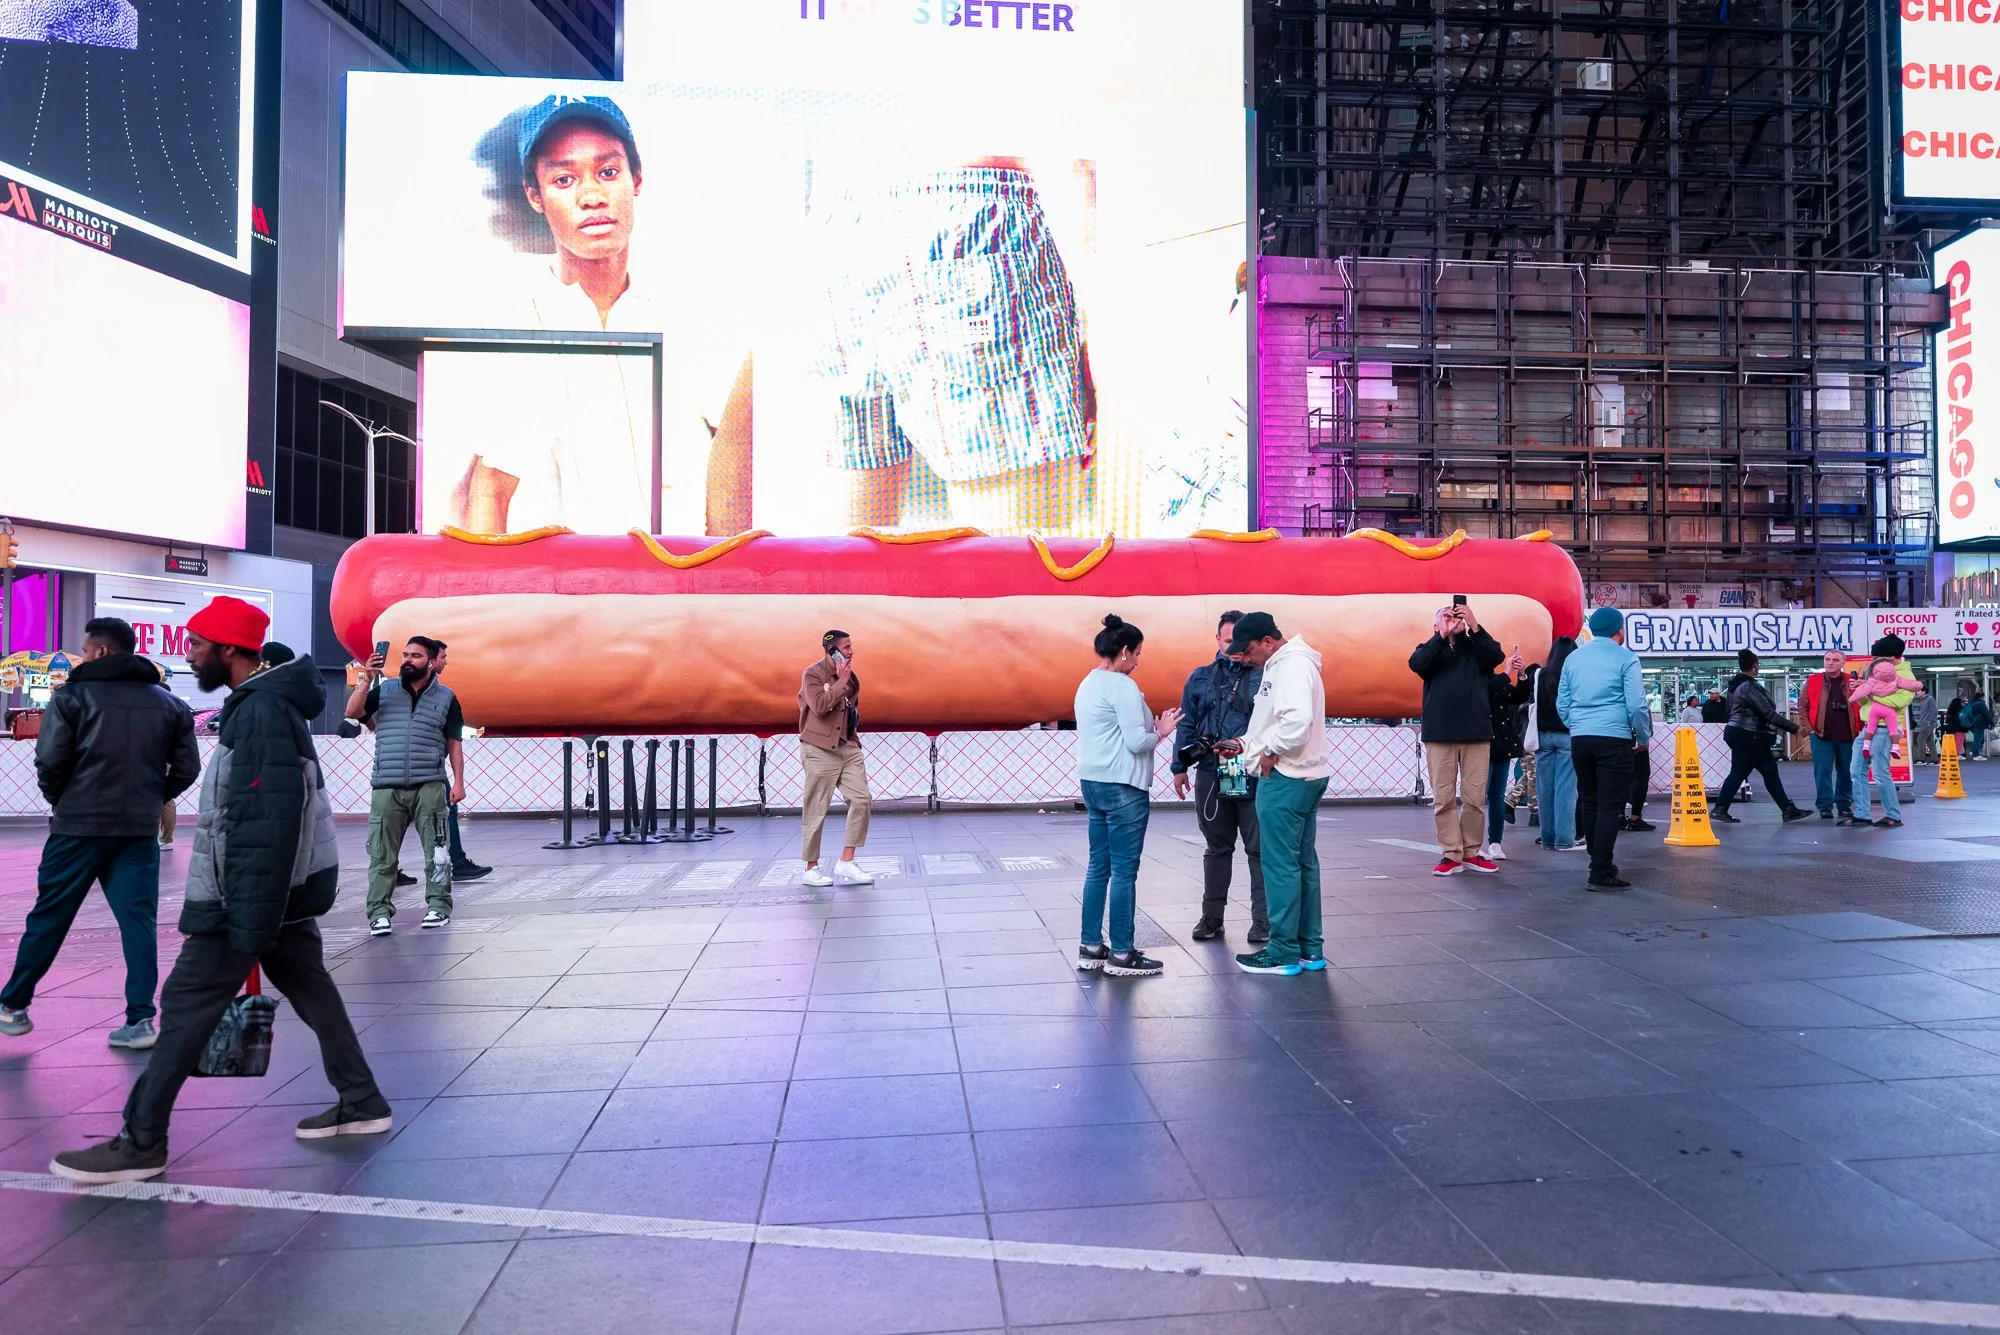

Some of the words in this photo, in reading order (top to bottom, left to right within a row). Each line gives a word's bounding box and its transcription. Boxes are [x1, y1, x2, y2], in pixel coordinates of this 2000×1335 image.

[941, 0, 1075, 32] BETTER
[1900, 0, 2000, 23] CHIC
[1902, 62, 2000, 92] CHIC
[1903, 130, 2000, 160] CHIC
[45, 198, 119, 236] MARRIOTT
[45, 213, 110, 247] MARQUIS
[1945, 260, 1976, 519] CHICAGO
[1876, 614, 1938, 624] DISCOUNT
[1954, 610, 1965, 618] #1
[1969, 610, 1993, 618] Rated
[1626, 613, 1750, 651] GRAND
[1753, 613, 1852, 651] SLAM
[1883, 627, 1916, 636] GIFTS
[1919, 627, 1928, 636] &
[1953, 637, 1982, 651] NY
